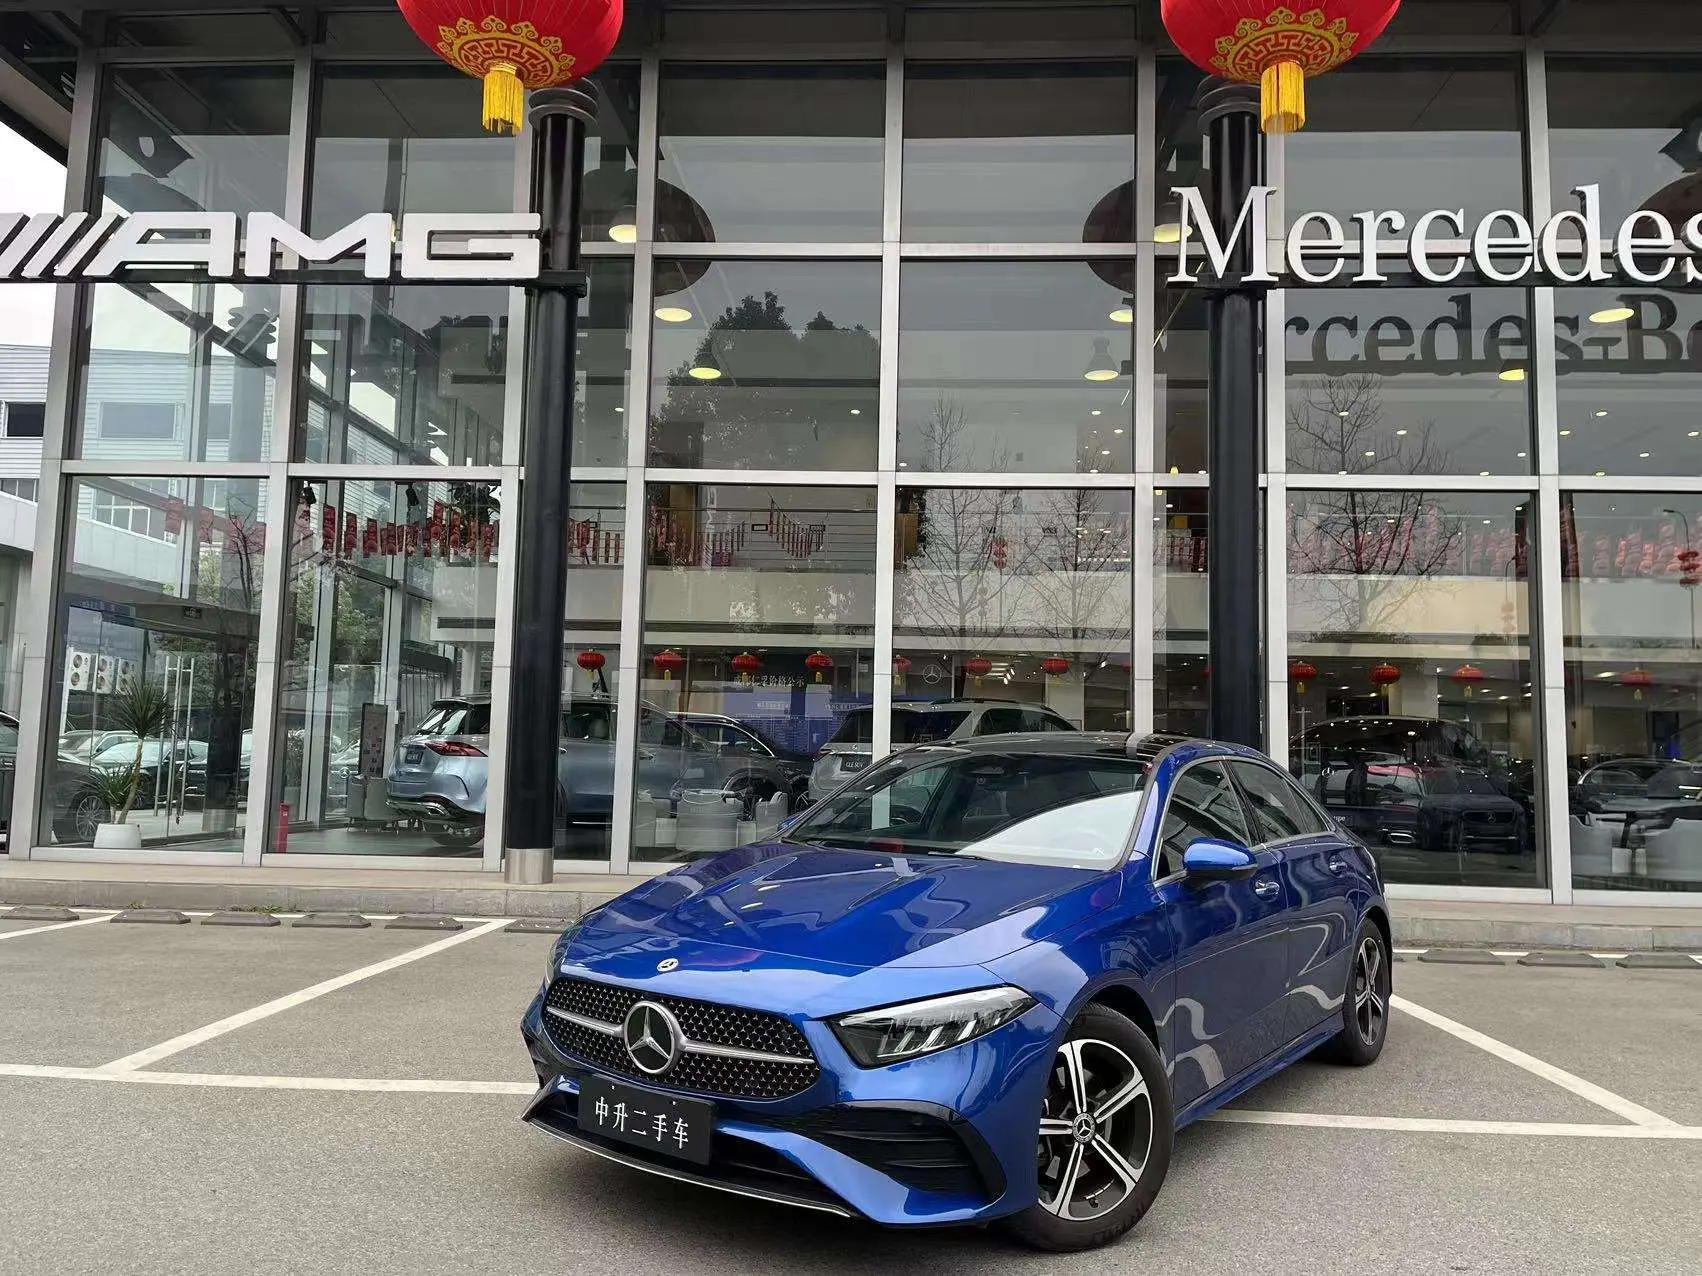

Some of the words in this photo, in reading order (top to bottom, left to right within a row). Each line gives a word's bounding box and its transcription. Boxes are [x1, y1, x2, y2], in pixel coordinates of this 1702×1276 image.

[595, 1096, 689, 1149] 中升二手车
